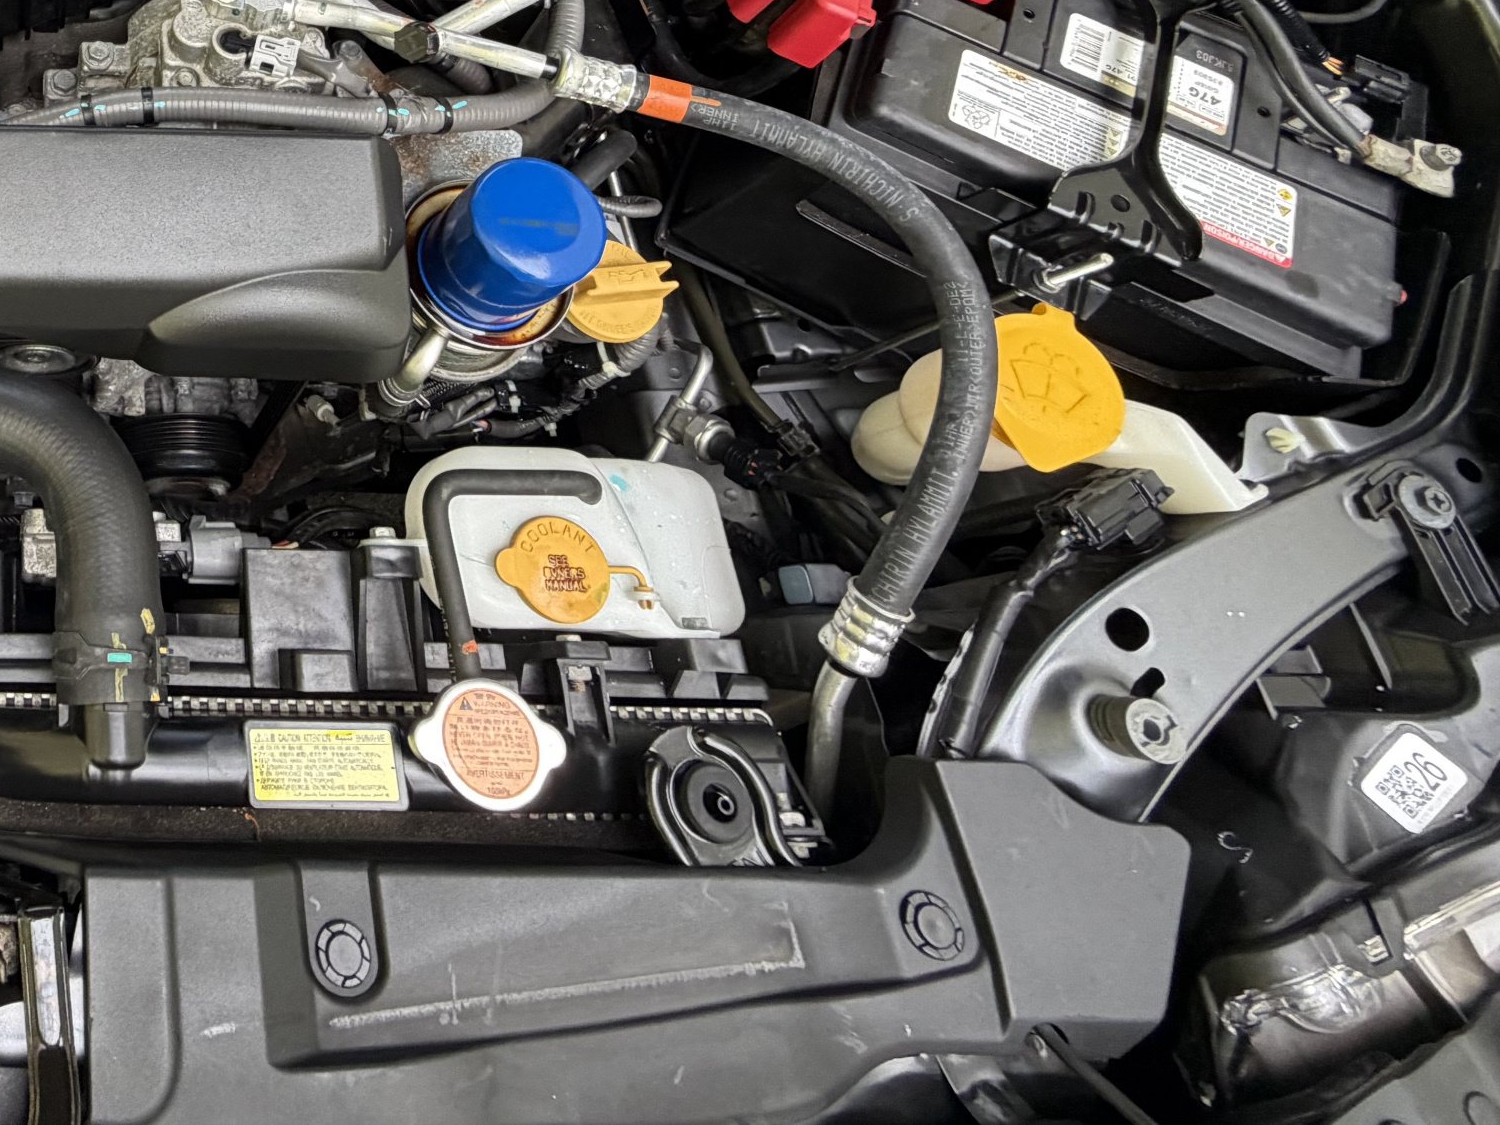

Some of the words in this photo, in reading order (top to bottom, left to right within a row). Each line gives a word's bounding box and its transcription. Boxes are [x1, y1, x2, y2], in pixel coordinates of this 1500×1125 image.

[1187, 85, 1222, 107] 47G
[520, 521, 596, 553] COOLANT
[548, 554, 569, 567] SEE
[1403, 752, 1448, 791] 26
